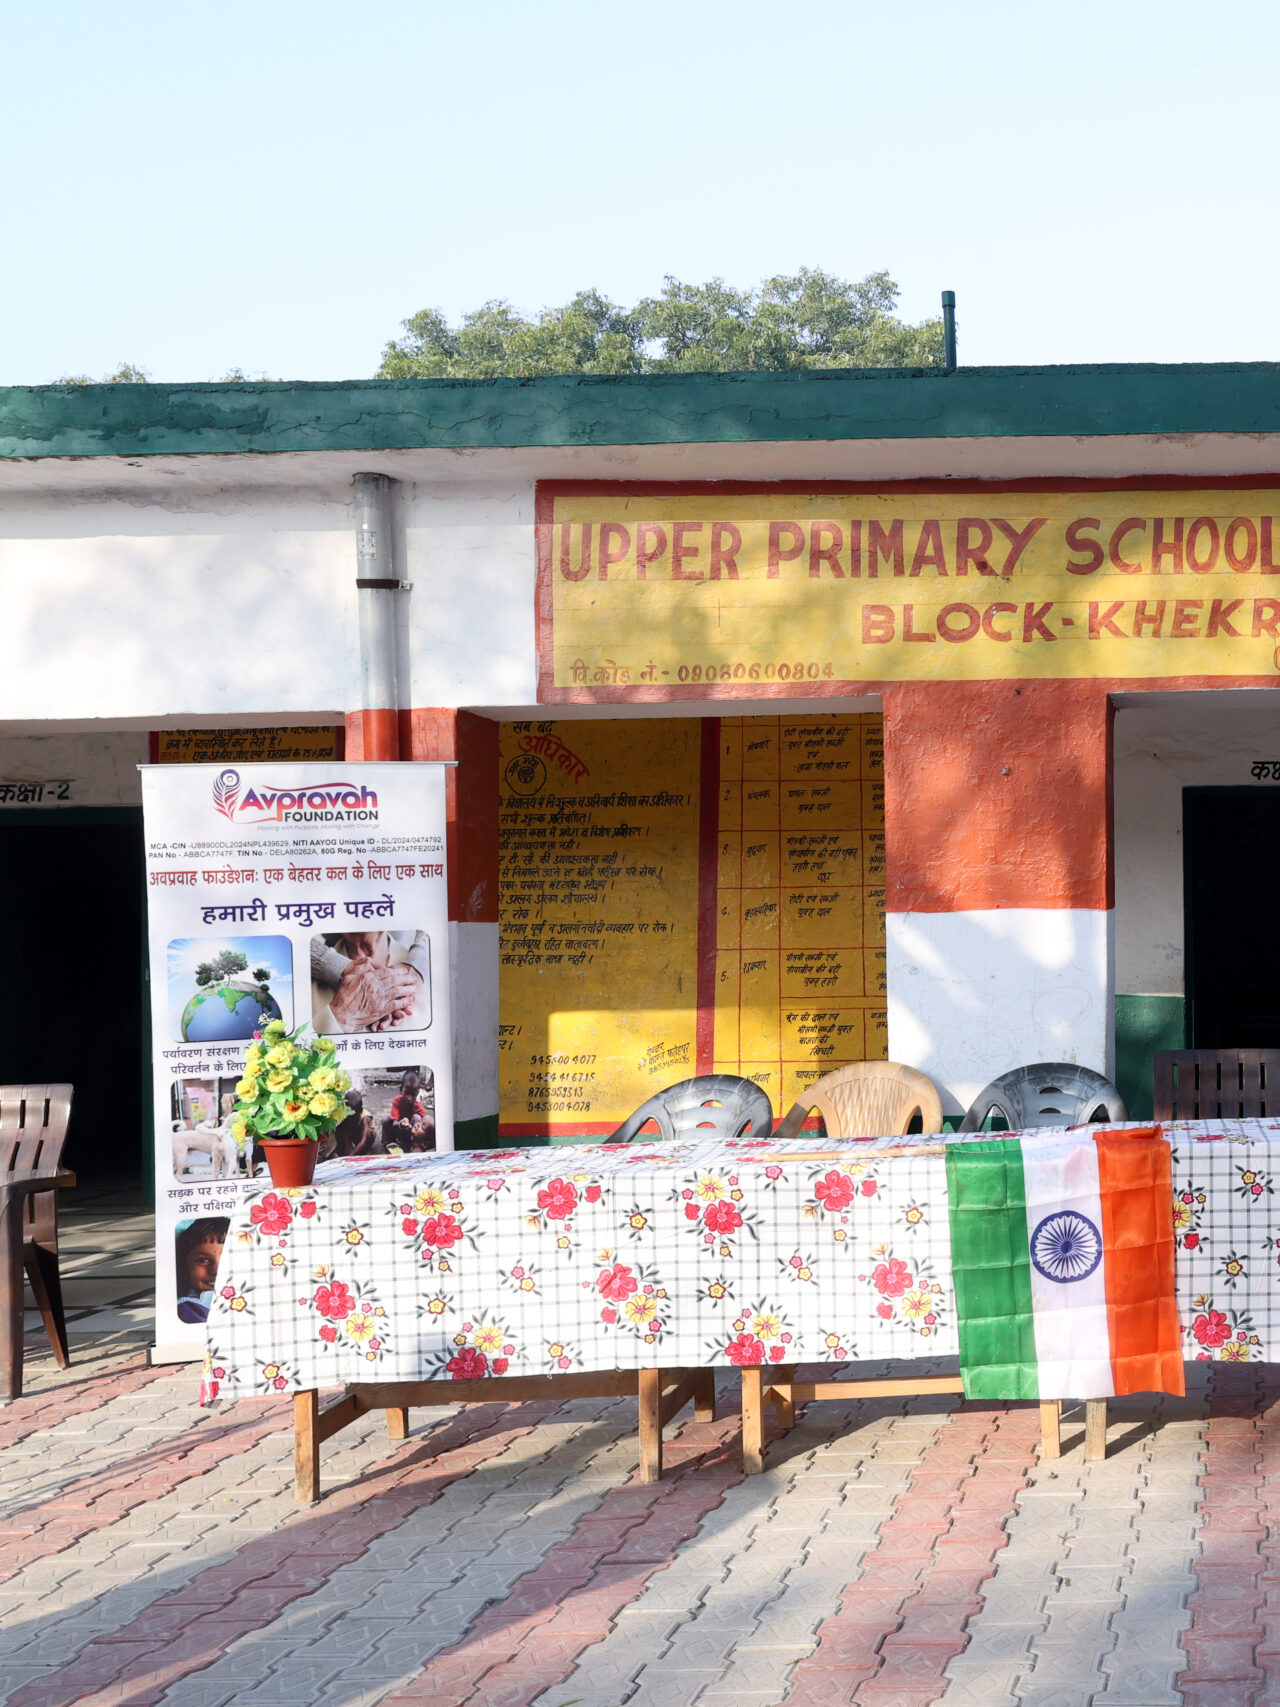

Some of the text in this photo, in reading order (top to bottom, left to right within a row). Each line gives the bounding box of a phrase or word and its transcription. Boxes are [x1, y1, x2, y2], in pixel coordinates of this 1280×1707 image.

[560, 520, 742, 583] UPPER
[767, 516, 1049, 580] PRIMARY
[518, 734, 590, 784] अधिकार
[238, 786, 378, 822] Avpravah
[285, 811, 378, 822] FOUNDATION
[339, 838, 365, 846] Unique
[149, 871, 198, 886] अवप्रवाह
[263, 868, 284, 884] एक
[288, 862, 322, 882] बेहतर
[326, 866, 348, 881] कल
[352, 861, 364, 880] के
[367, 860, 392, 880] लिए
[395, 864, 415, 880] एक
[419, 863, 444, 878] साथ
[201, 894, 395, 927] हमारी प्रमुख पहलें
[163, 1048, 203, 1059] पर्यावरण
[206, 1045, 240, 1057] संरक्षण
[352, 1038, 427, 1051] के लिए देखभाल
[170, 1061, 210, 1074] परिवर्तन
[214, 1060, 223, 1071] के
[167, 1188, 194, 1199] सड़क
[198, 1187, 212, 1196] पर
[216, 1182, 238, 1195] रहने
[178, 1202, 199, 1213] और
